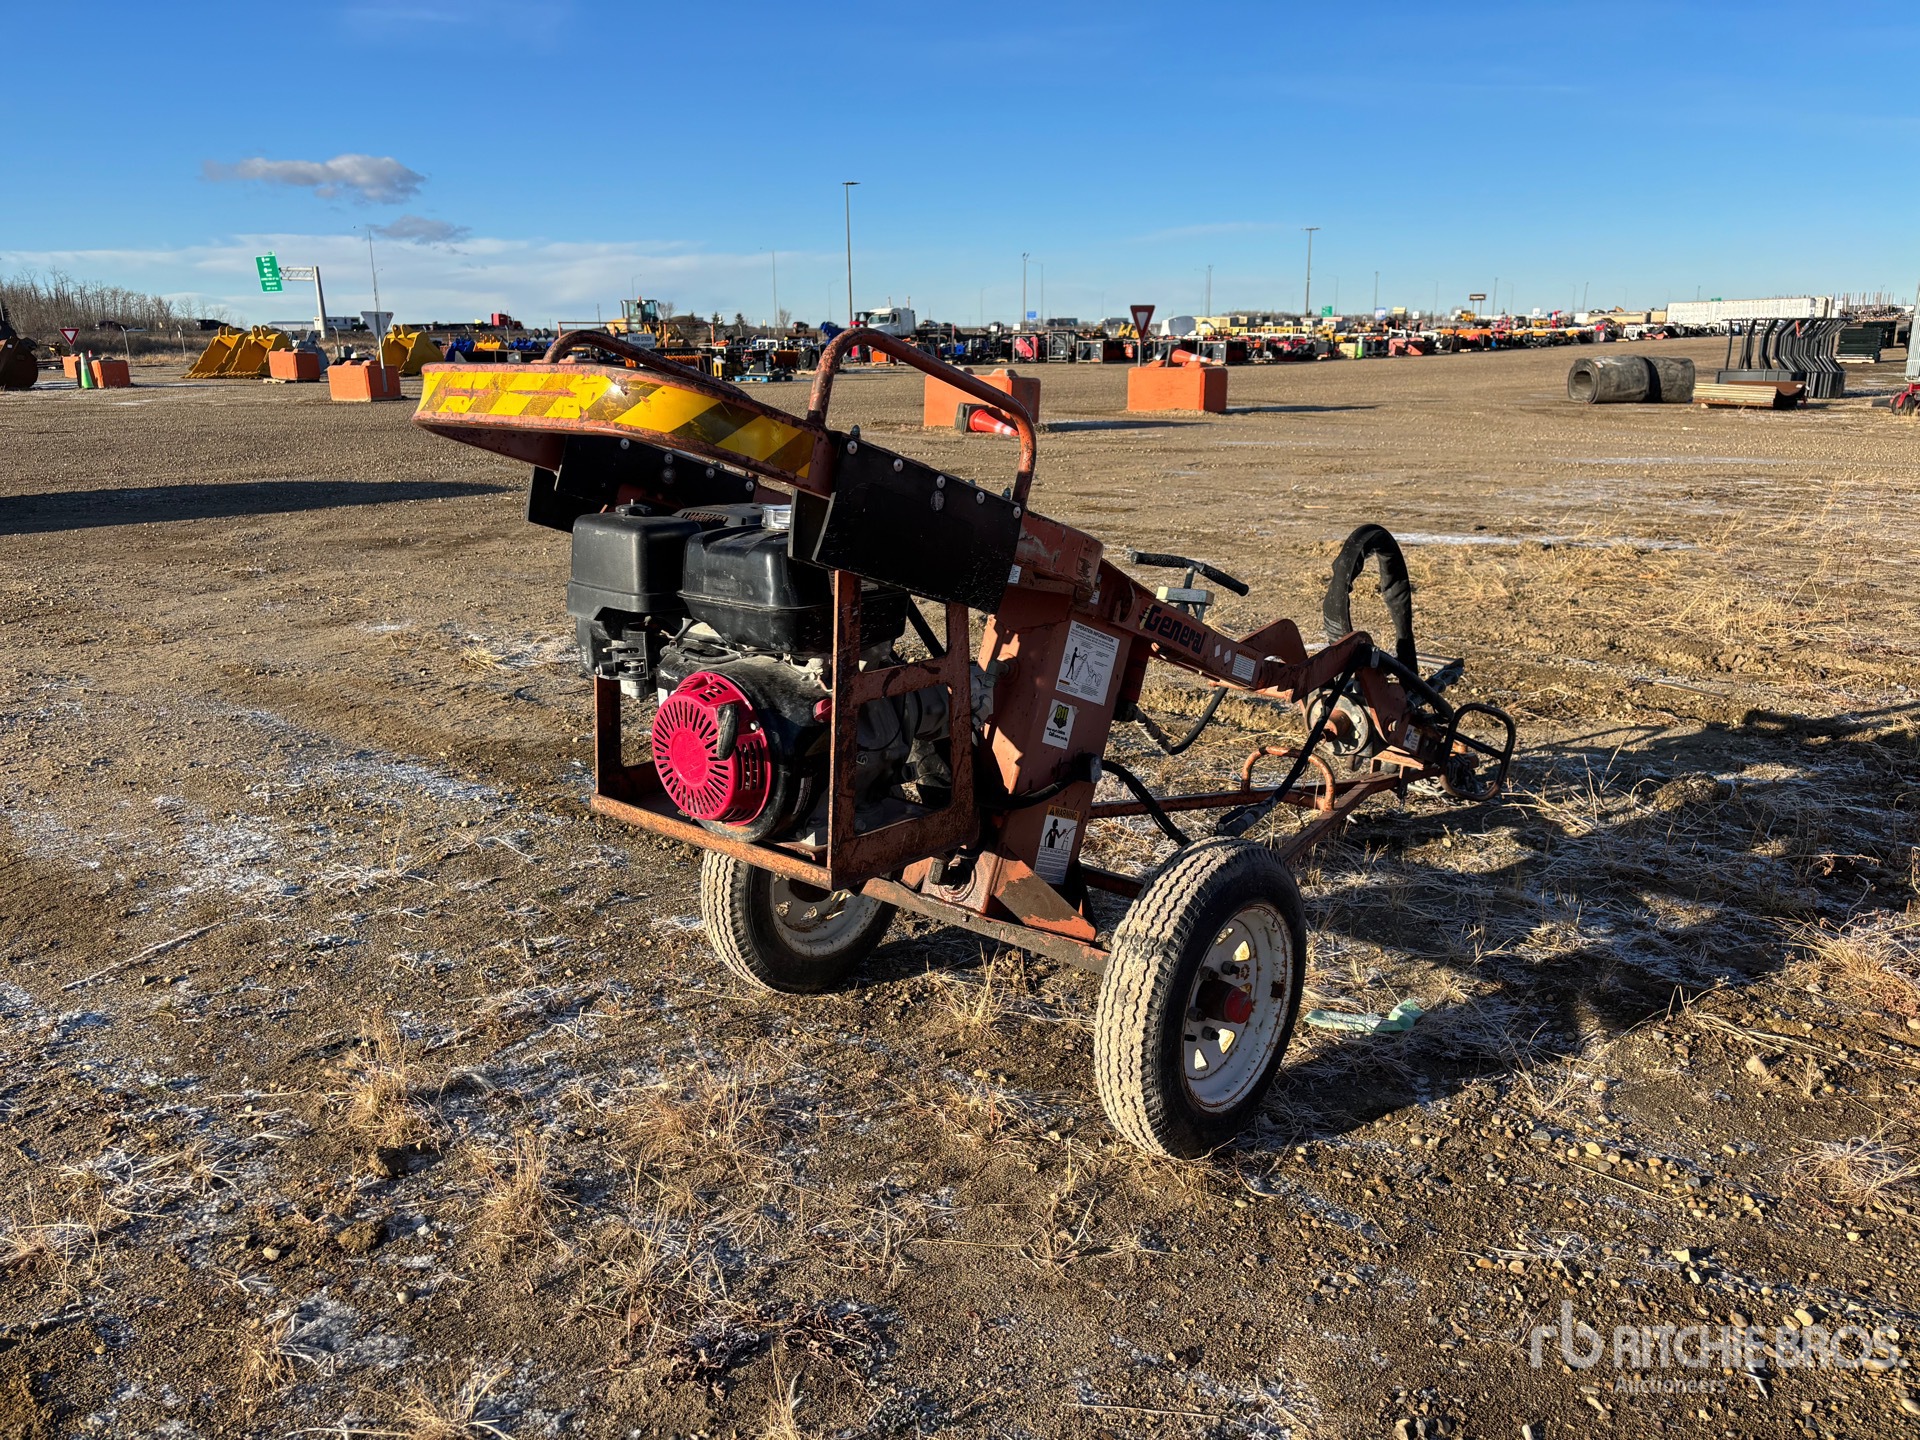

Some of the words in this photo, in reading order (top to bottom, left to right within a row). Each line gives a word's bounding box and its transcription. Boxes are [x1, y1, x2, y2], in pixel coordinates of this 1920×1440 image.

[1075, 623, 1093, 636] OPERATION
[1093, 630, 1114, 643] INFORMATION
[1144, 605, 1207, 655] General
[1056, 706, 1068, 720] 811
[1055, 807, 1078, 821] WARNING
